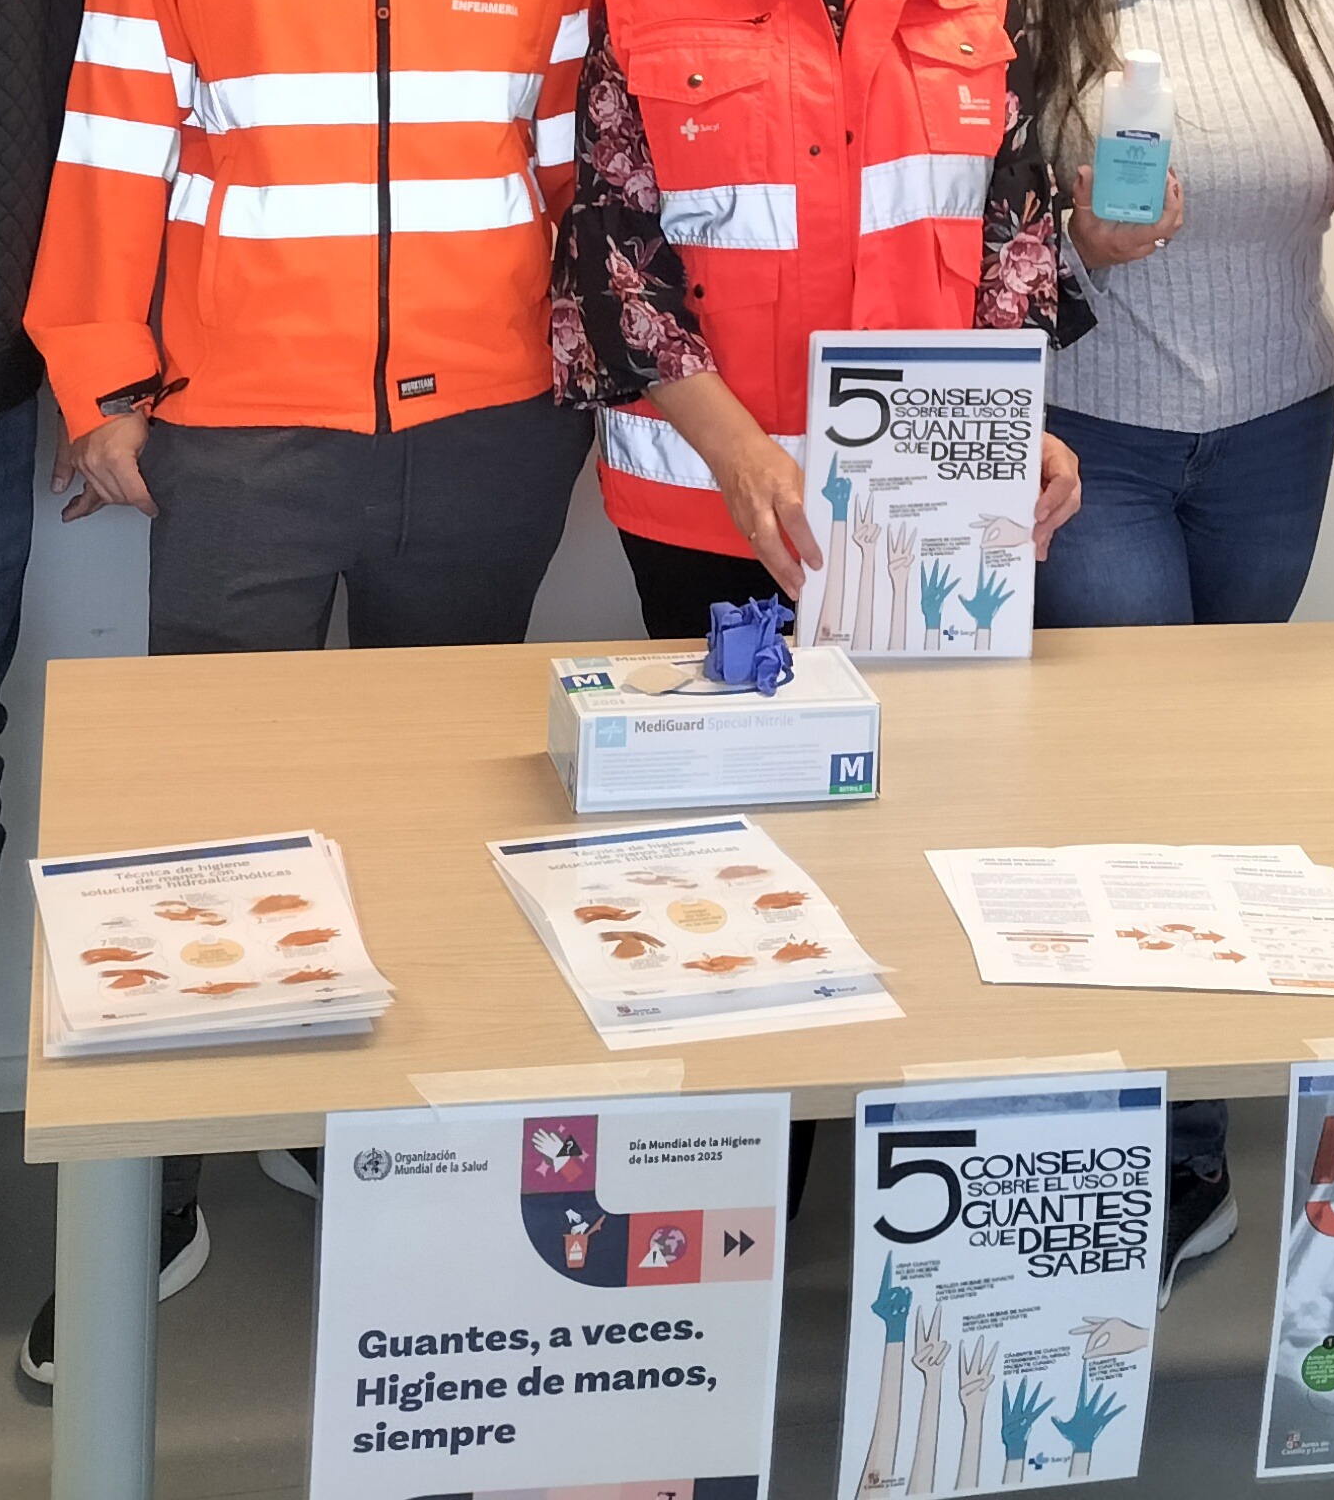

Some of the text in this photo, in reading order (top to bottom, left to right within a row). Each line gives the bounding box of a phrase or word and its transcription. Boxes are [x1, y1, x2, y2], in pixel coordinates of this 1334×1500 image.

[700, 123, 719, 132] Sacyl
[826, 367, 904, 447] 5
[890, 389, 1032, 406] CONSEJOS
[895, 407, 1029, 418] SOBRE USO DE
[890, 420, 1031, 440] GUANTES
[895, 442, 1028, 461] QUE DEBES
[938, 462, 1026, 480] SABER
[572, 675, 601, 687] M
[635, 714, 794, 733] MediGuard Special Nitrile
[839, 757, 864, 782] M
[116, 860, 250, 880] Técnica higiene
[81, 884, 161, 897] soluciones
[630, 1136, 760, 1150] Día Mundial Higiene
[395, 1150, 456, 1166] Organización
[395, 1160, 488, 1174] Mundial Salud
[662, 1152, 722, 1162] Manos 2025
[961, 1146, 1151, 1180] CONSEJOS
[874, 1130, 977, 1244] 5
[968, 1171, 1149, 1197] SOBRE EL USO DE
[962, 1190, 1152, 1230] GUANTES
[969, 1220, 1148, 1255] QUE DEBES
[1028, 1247, 1146, 1278] SABER
[359, 1320, 703, 1359] Guantes, a veces.
[357, 1366, 716, 1412] Higiene de manos,
[353, 1422, 515, 1455] siempre
